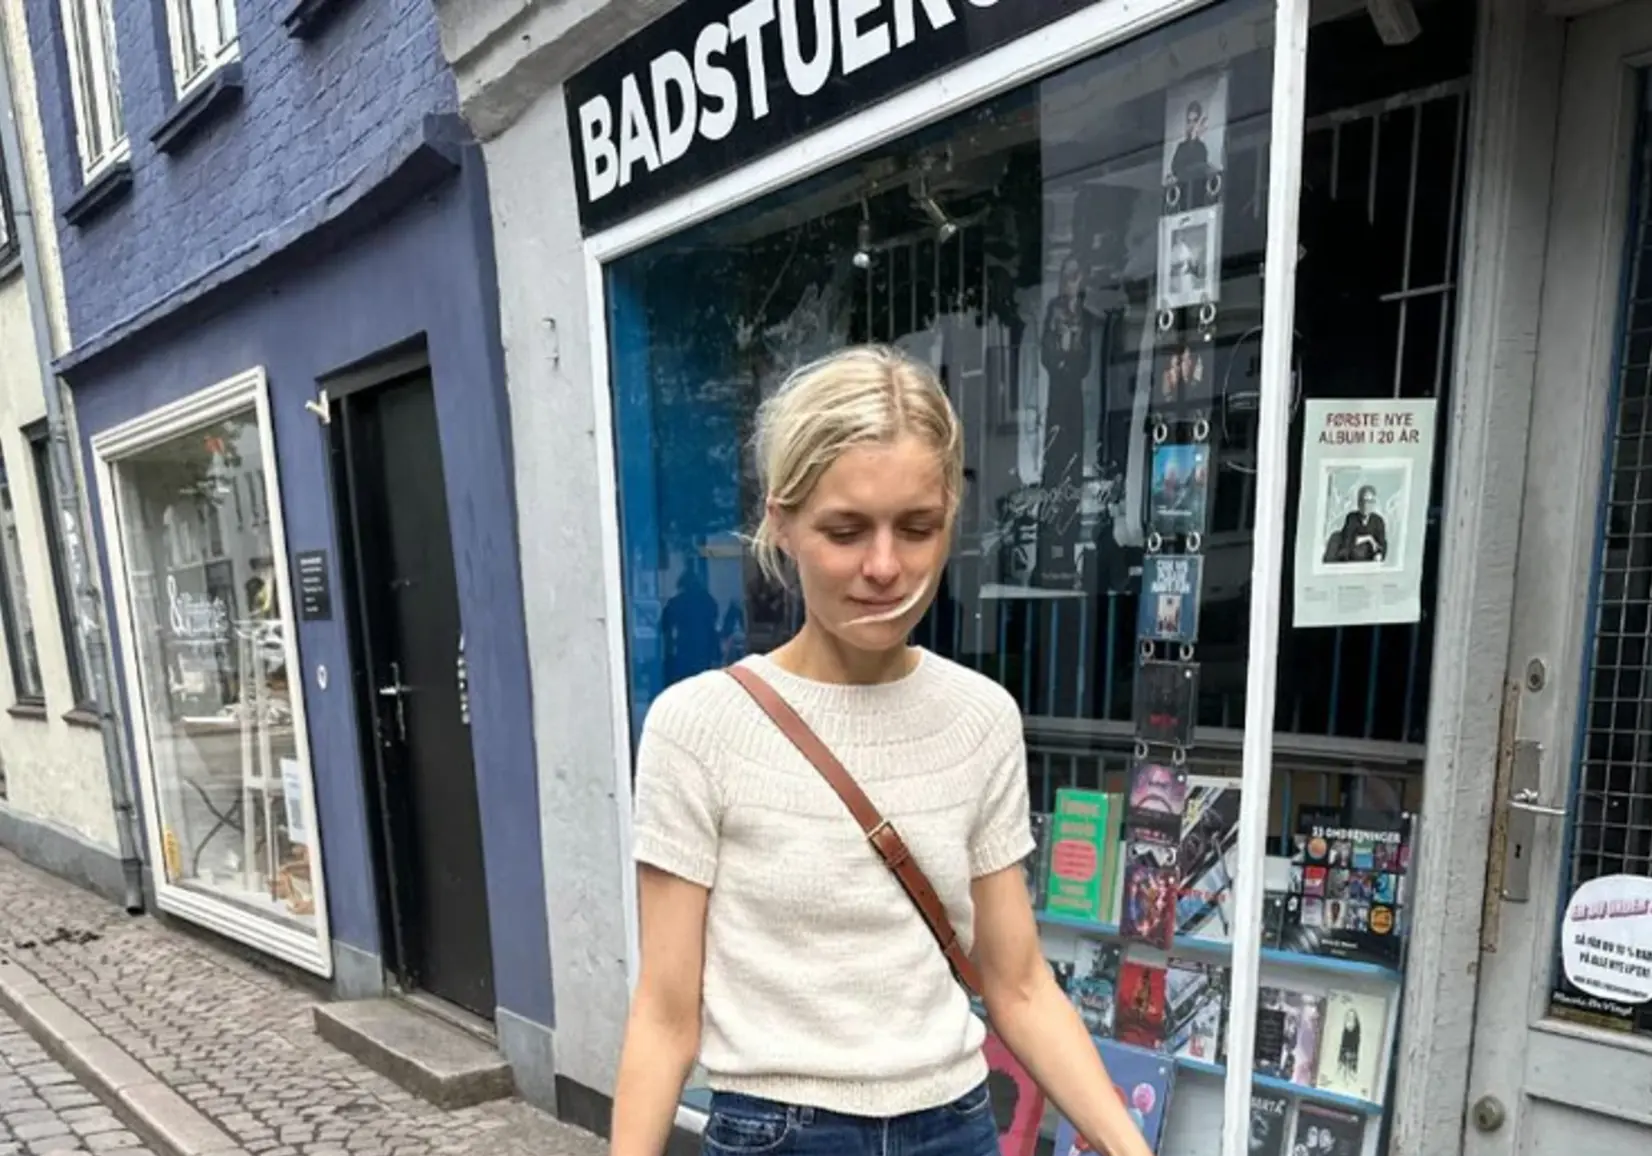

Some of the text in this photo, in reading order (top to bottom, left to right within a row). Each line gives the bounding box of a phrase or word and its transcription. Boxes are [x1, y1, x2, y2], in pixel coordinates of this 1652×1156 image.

[579, 0, 999, 202] BADSTUE
[1326, 412, 1414, 428] FØRSTE NYE
[1319, 427, 1419, 445] ALBUM I 20 ÅR
